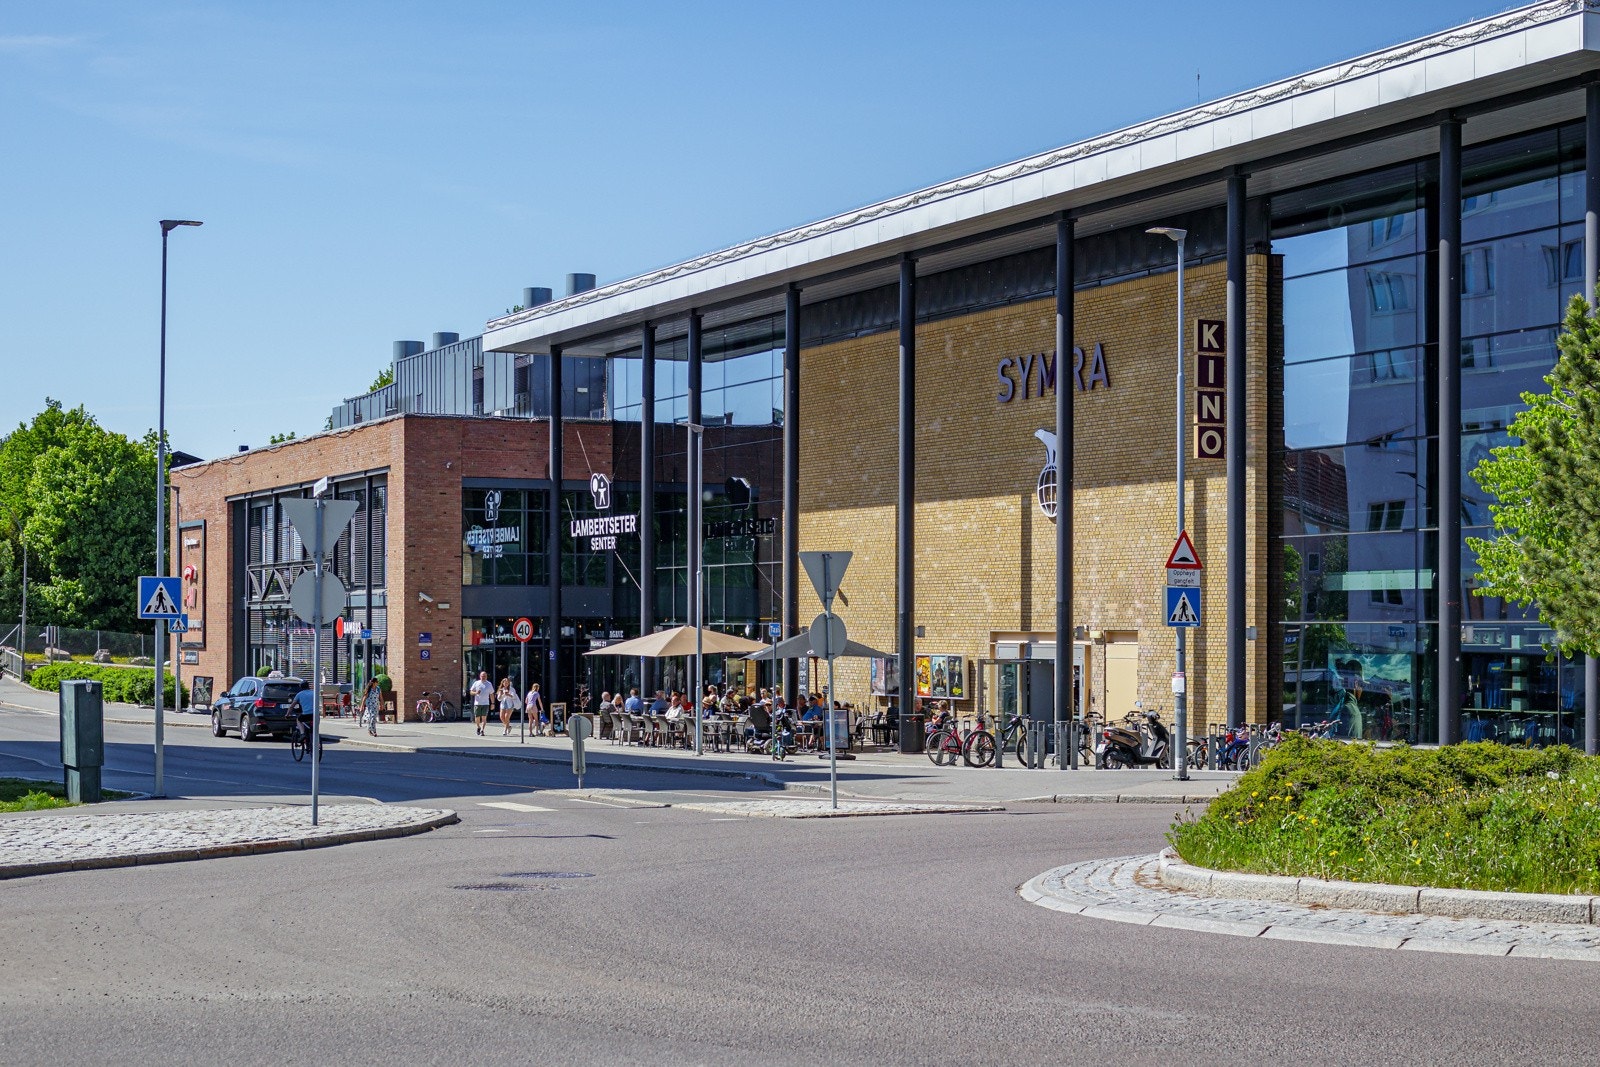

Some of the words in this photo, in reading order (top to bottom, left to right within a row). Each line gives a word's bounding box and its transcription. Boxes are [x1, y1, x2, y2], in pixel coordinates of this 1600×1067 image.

[997, 342, 1110, 403] SYMRA
[1201, 324, 1222, 455] KINO
[570, 515, 636, 537] LAMBERTSETER
[591, 537, 616, 550] SENTER
[518, 625, 530, 636] 40
